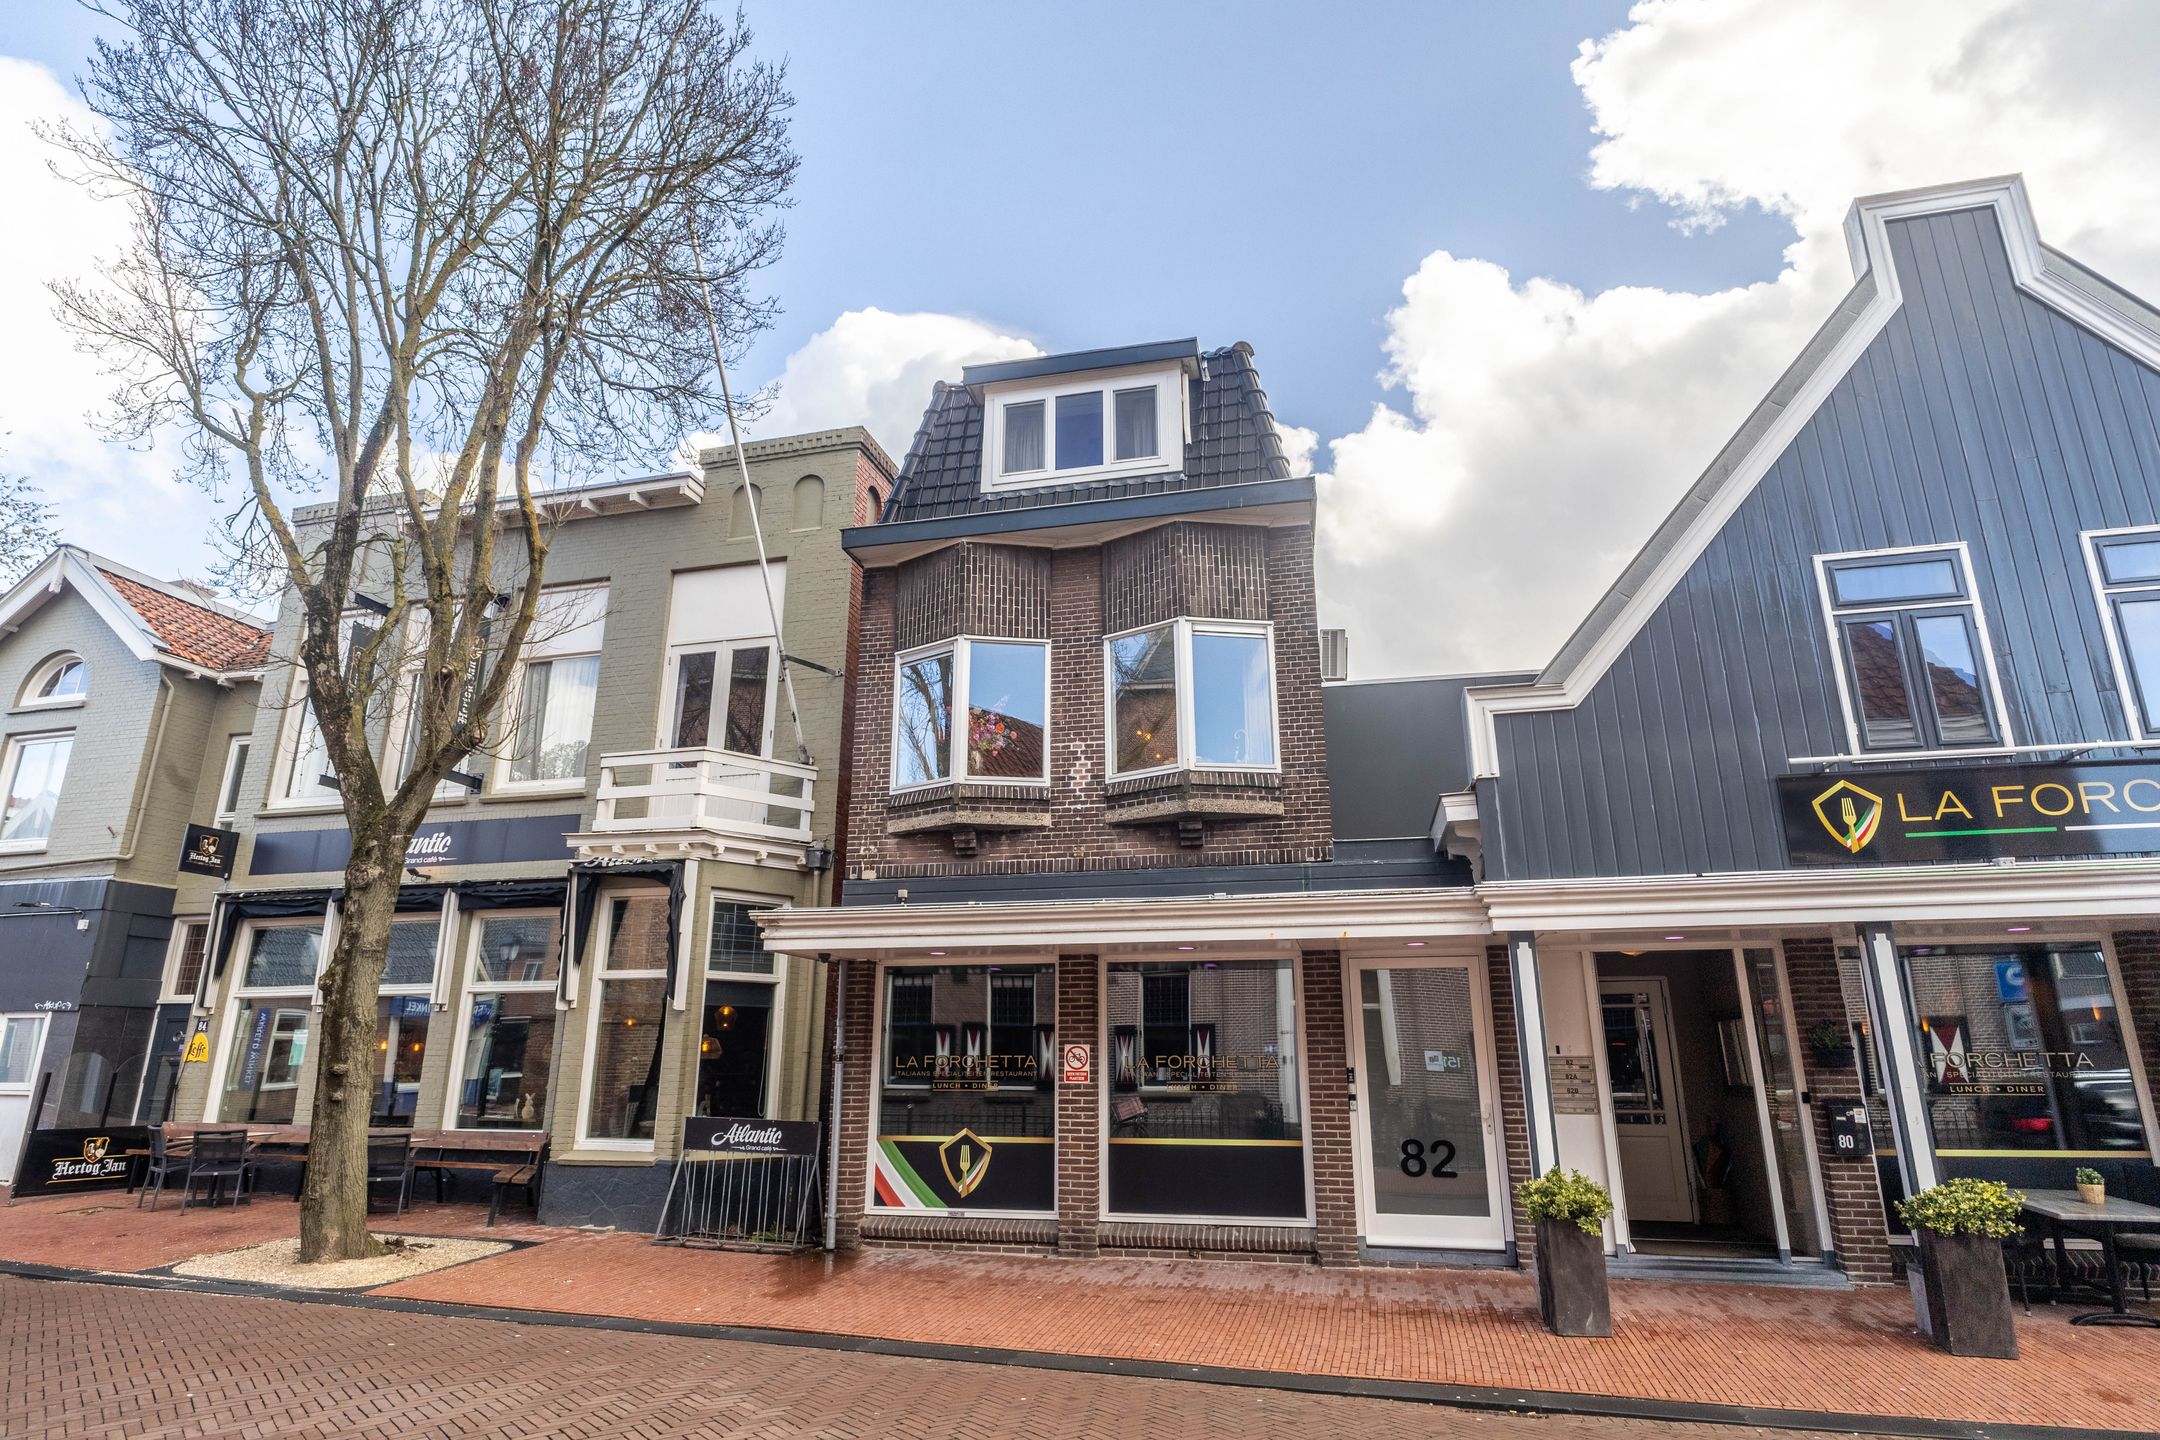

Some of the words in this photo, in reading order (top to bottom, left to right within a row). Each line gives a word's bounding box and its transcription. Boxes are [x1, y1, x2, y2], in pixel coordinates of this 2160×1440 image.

[1897, 790, 1974, 823] LA
[197, 1021, 207, 1031] 84
[895, 1055, 919, 1068] LA
[924, 1055, 1038, 1068] FORCHETTA
[1125, 1056, 1150, 1069] LA
[1155, 1055, 1281, 1069] FORCHETTA
[1930, 1052, 2095, 1068] FORCHETTA
[1949, 1085, 1990, 1093] LUNCH
[2006, 1085, 2045, 1093] DINER
[711, 1123, 782, 1146] Atlantic
[1838, 1134, 1854, 1149] 80
[1400, 1139, 1458, 1178] 82
[52, 1161, 101, 1180] Hertog
[100, 1158, 127, 1177] Jan
